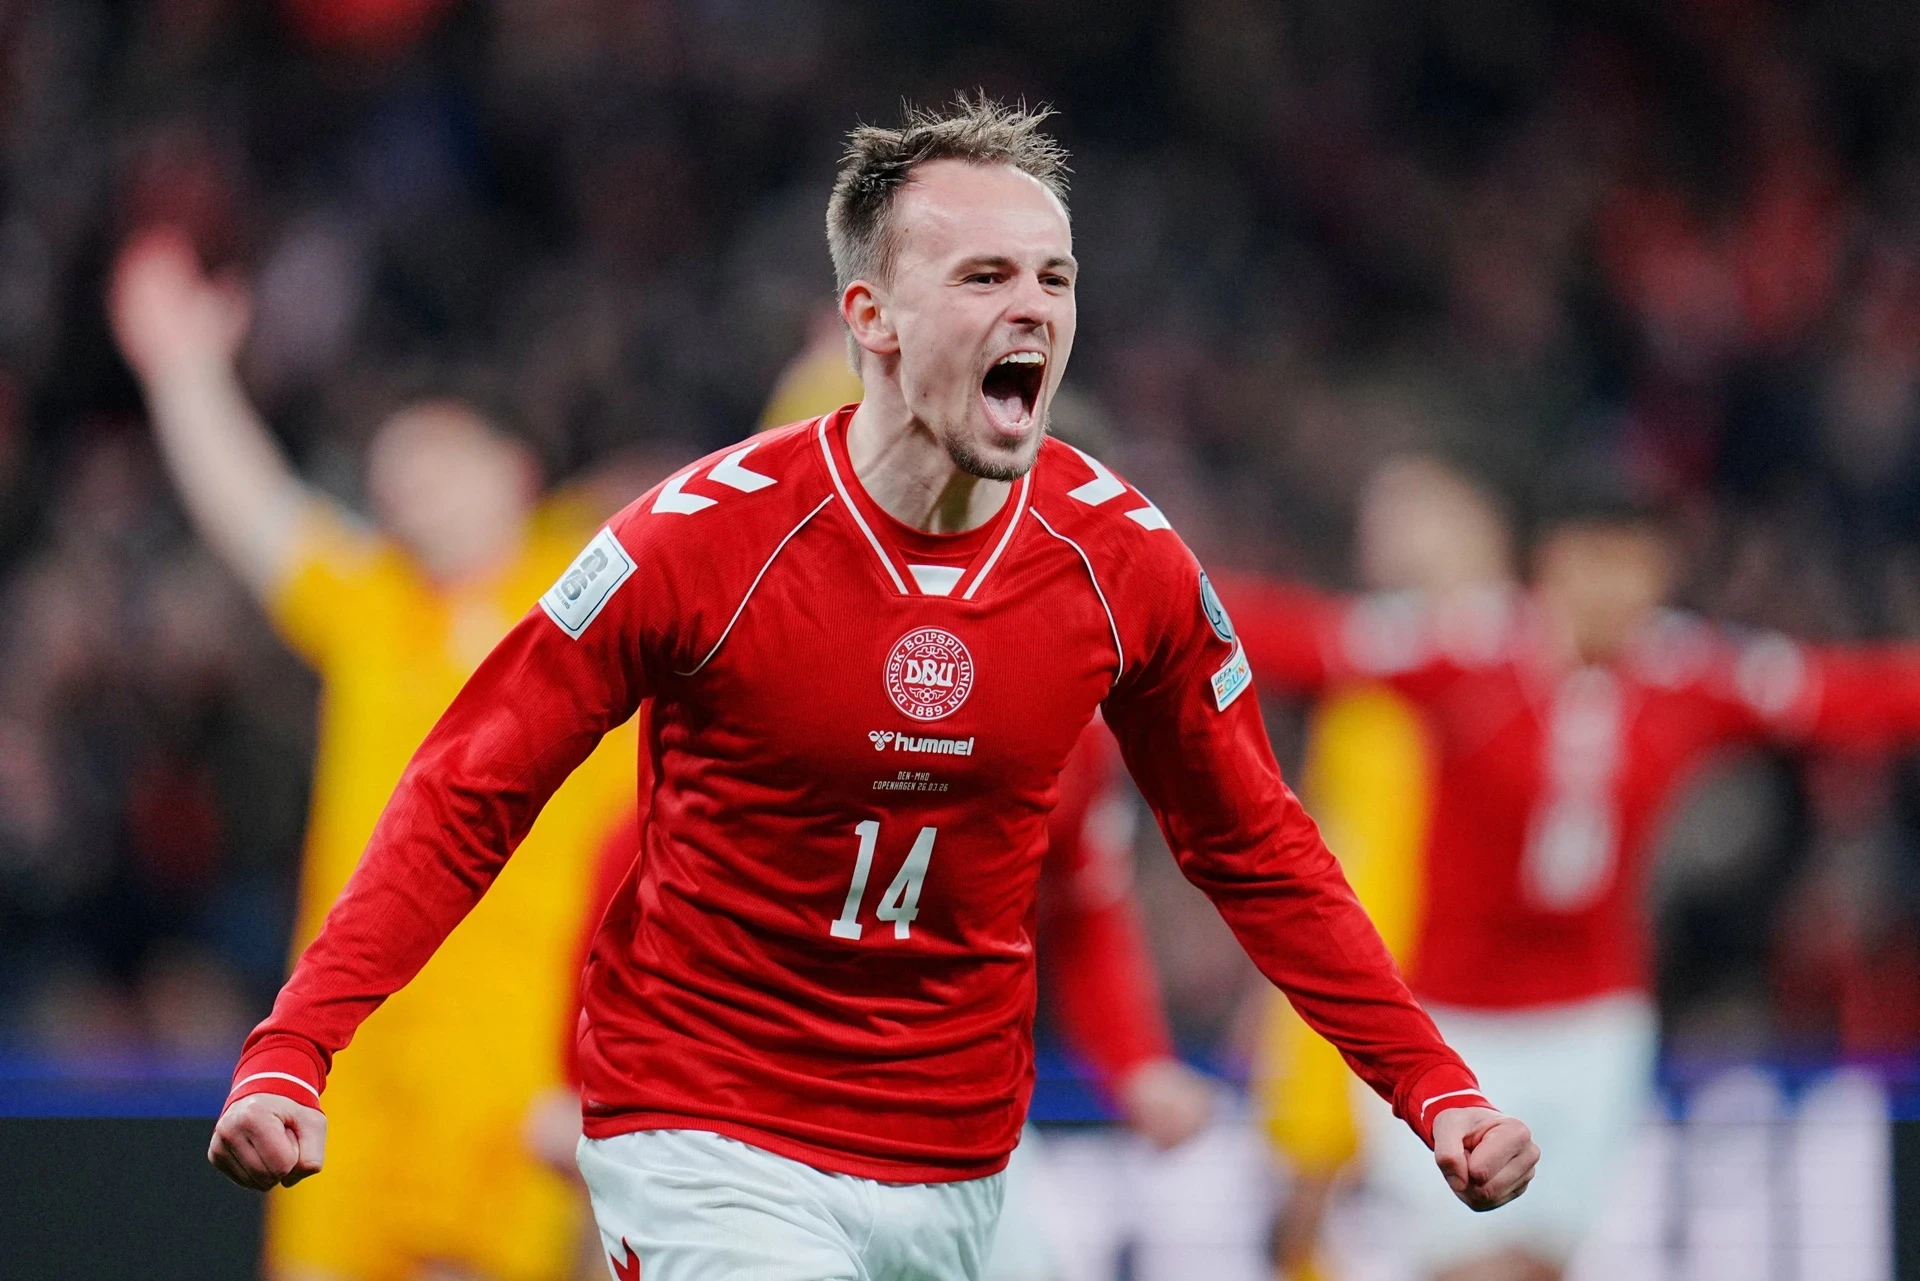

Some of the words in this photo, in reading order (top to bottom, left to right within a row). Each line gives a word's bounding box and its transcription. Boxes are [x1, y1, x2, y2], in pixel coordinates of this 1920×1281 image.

[890, 652, 907, 705] DANSK
[904, 659, 955, 687] DBU
[909, 704, 943, 717] 1889
[894, 732, 974, 756] hummel
[872, 781, 916, 791] COPENHAGEN
[917, 782, 948, 792] 26.03.26
[830, 820, 937, 940] 14
